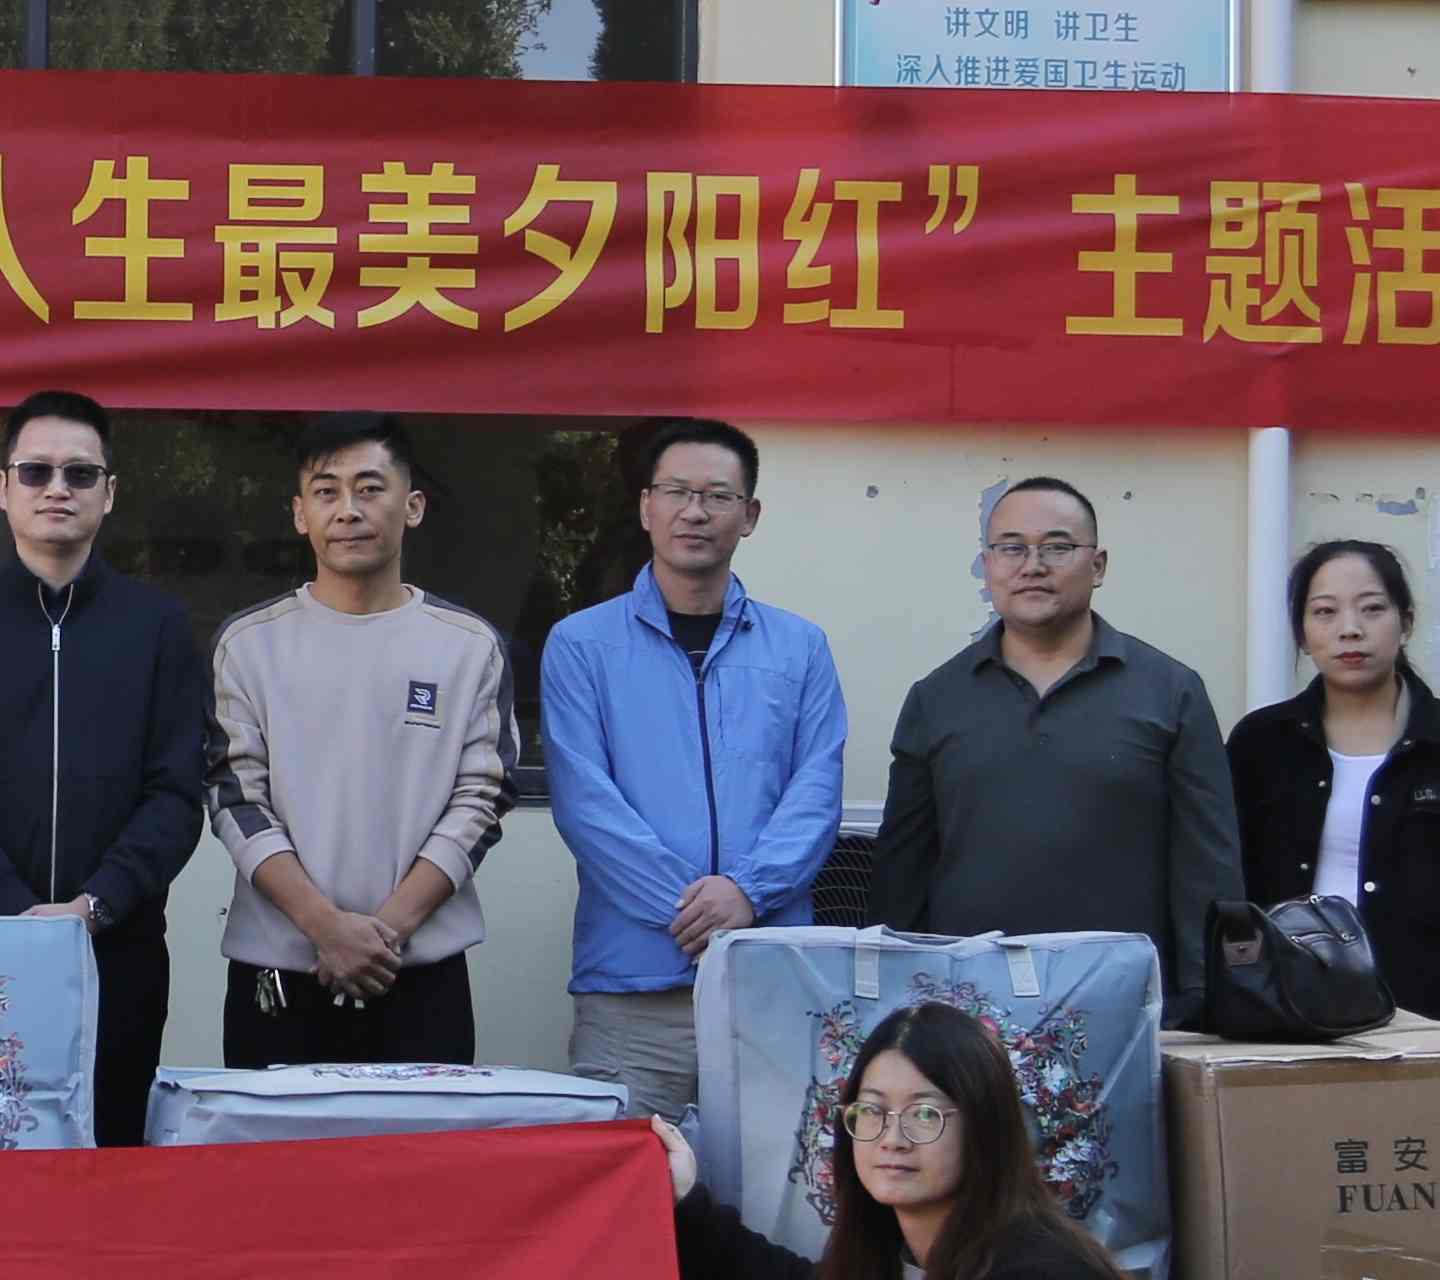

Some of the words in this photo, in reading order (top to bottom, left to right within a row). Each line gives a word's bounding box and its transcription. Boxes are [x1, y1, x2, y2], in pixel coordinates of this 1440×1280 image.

[944, 6, 1029, 40] 讲文明
[1055, 11, 1139, 43] 讲卫生
[896, 54, 1186, 91] 深入推进爱国卫生运动
